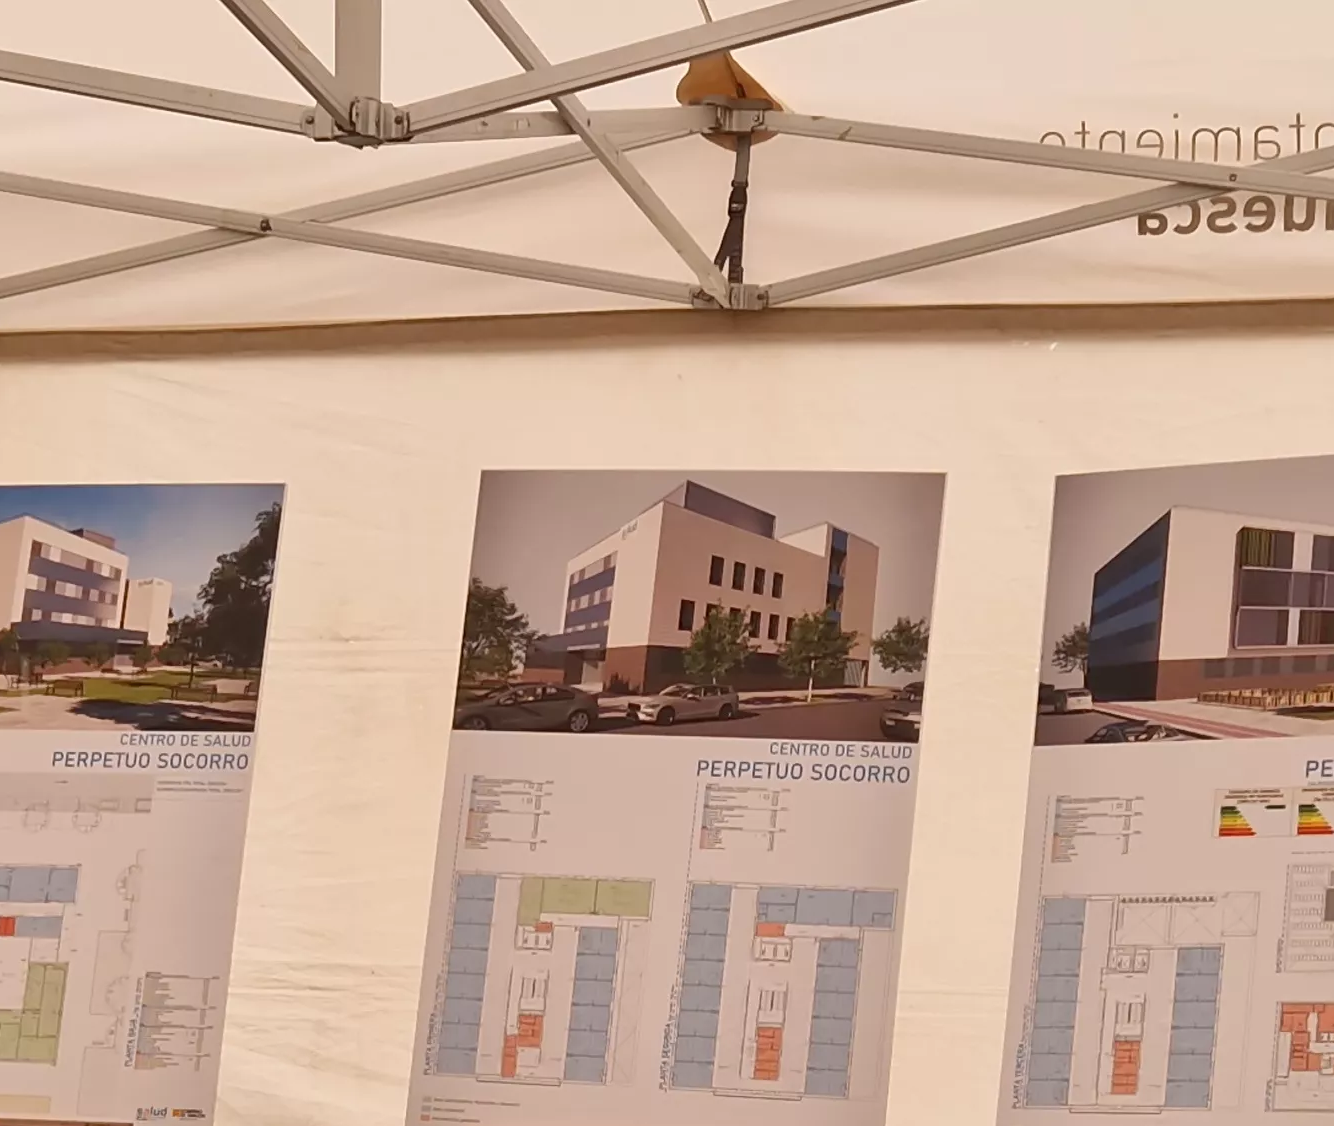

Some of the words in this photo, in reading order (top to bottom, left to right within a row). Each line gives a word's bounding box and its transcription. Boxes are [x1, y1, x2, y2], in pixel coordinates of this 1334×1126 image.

[120, 733, 176, 746] CENTRO
[180, 734, 199, 747] DE
[203, 734, 251, 747] SALUD
[769, 742, 830, 757] CENTRO
[835, 743, 855, 758] DE
[860, 745, 913, 760] SALUD
[51, 751, 151, 769] PERPETUO
[156, 753, 249, 770] SOCORRO
[697, 759, 803, 781] PERPETUO
[810, 763, 911, 784] SOCORRO
